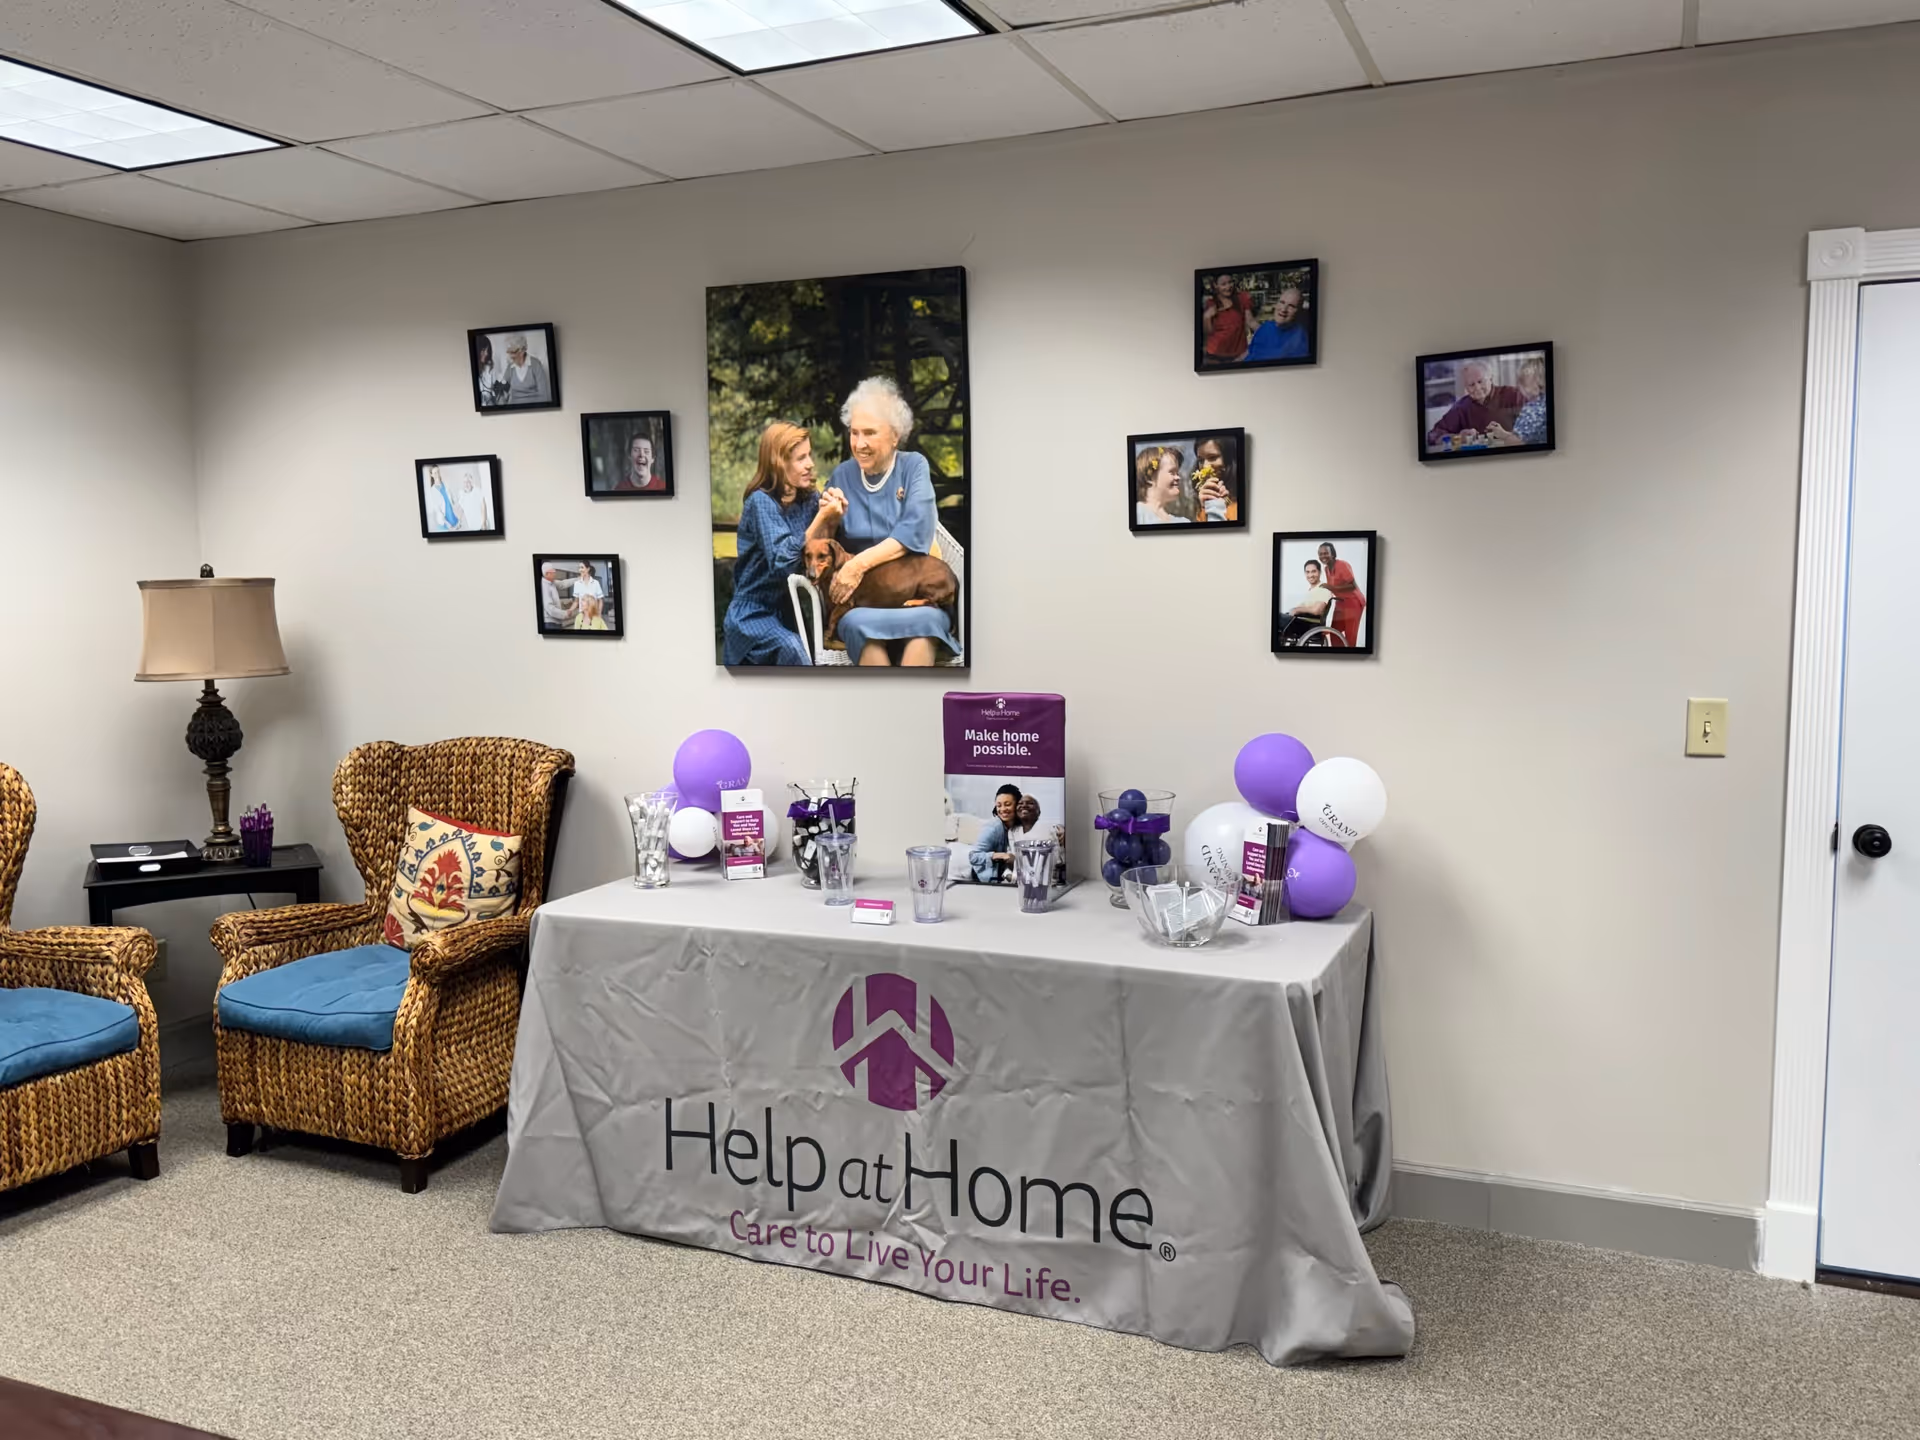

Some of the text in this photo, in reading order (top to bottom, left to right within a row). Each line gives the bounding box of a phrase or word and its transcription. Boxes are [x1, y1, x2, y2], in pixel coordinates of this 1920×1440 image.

[981, 708, 995, 717] Help
[964, 728, 1039, 742] Make home
[973, 742, 1031, 757] possible.
[719, 777, 749, 789] GRAN
[1318, 817, 1341, 838] OPENIN
[1322, 803, 1358, 837] GRAND
[665, 1097, 826, 1211] Help
[839, 1153, 893, 1204] at
[904, 1131, 1153, 1250] Home
[730, 1210, 1080, 1304] Care to Live Your Life.
